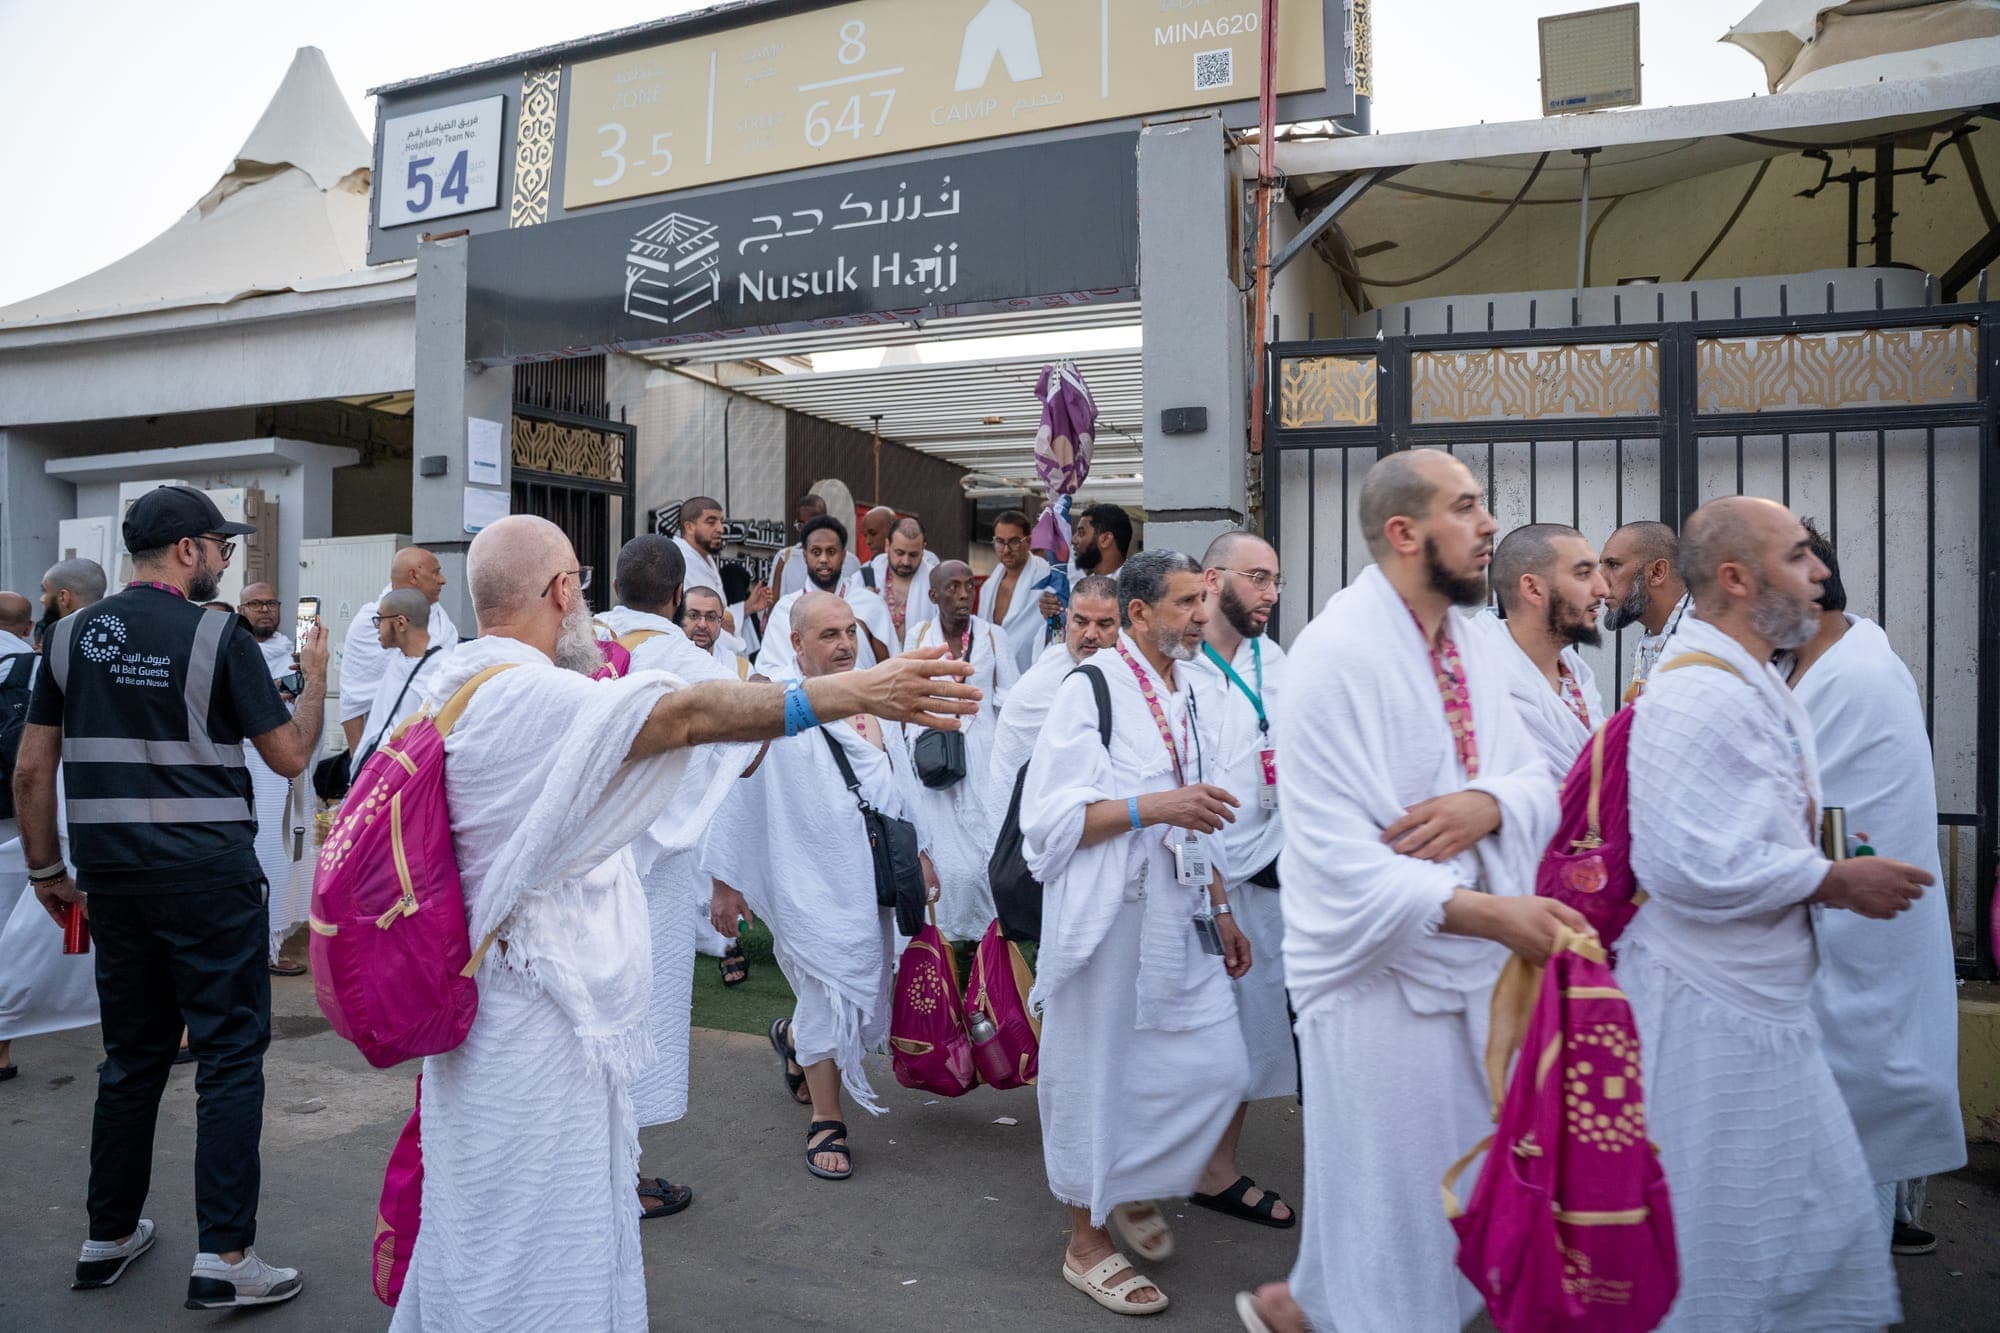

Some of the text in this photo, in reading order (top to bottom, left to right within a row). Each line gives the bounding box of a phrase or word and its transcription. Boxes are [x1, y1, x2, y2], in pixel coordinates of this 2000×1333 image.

[837, 19, 866, 66] 8
[1154, 12, 1258, 47] MINA620
[458, 114, 479, 130] فريق
[804, 88, 896, 148] 647
[930, 96, 998, 127] CAMP
[405, 131, 477, 152] Hospitality Team No.
[592, 123, 673, 187] 3-5
[406, 149, 469, 214] 54
[738, 208, 824, 256] حج
[739, 242, 959, 305] Nusuk Hajj
[110, 665, 120, 674] Al
[138, 666, 169, 678] Guests
[143, 654, 170, 666] ضيوف
[146, 678, 169, 688] Nusuk
